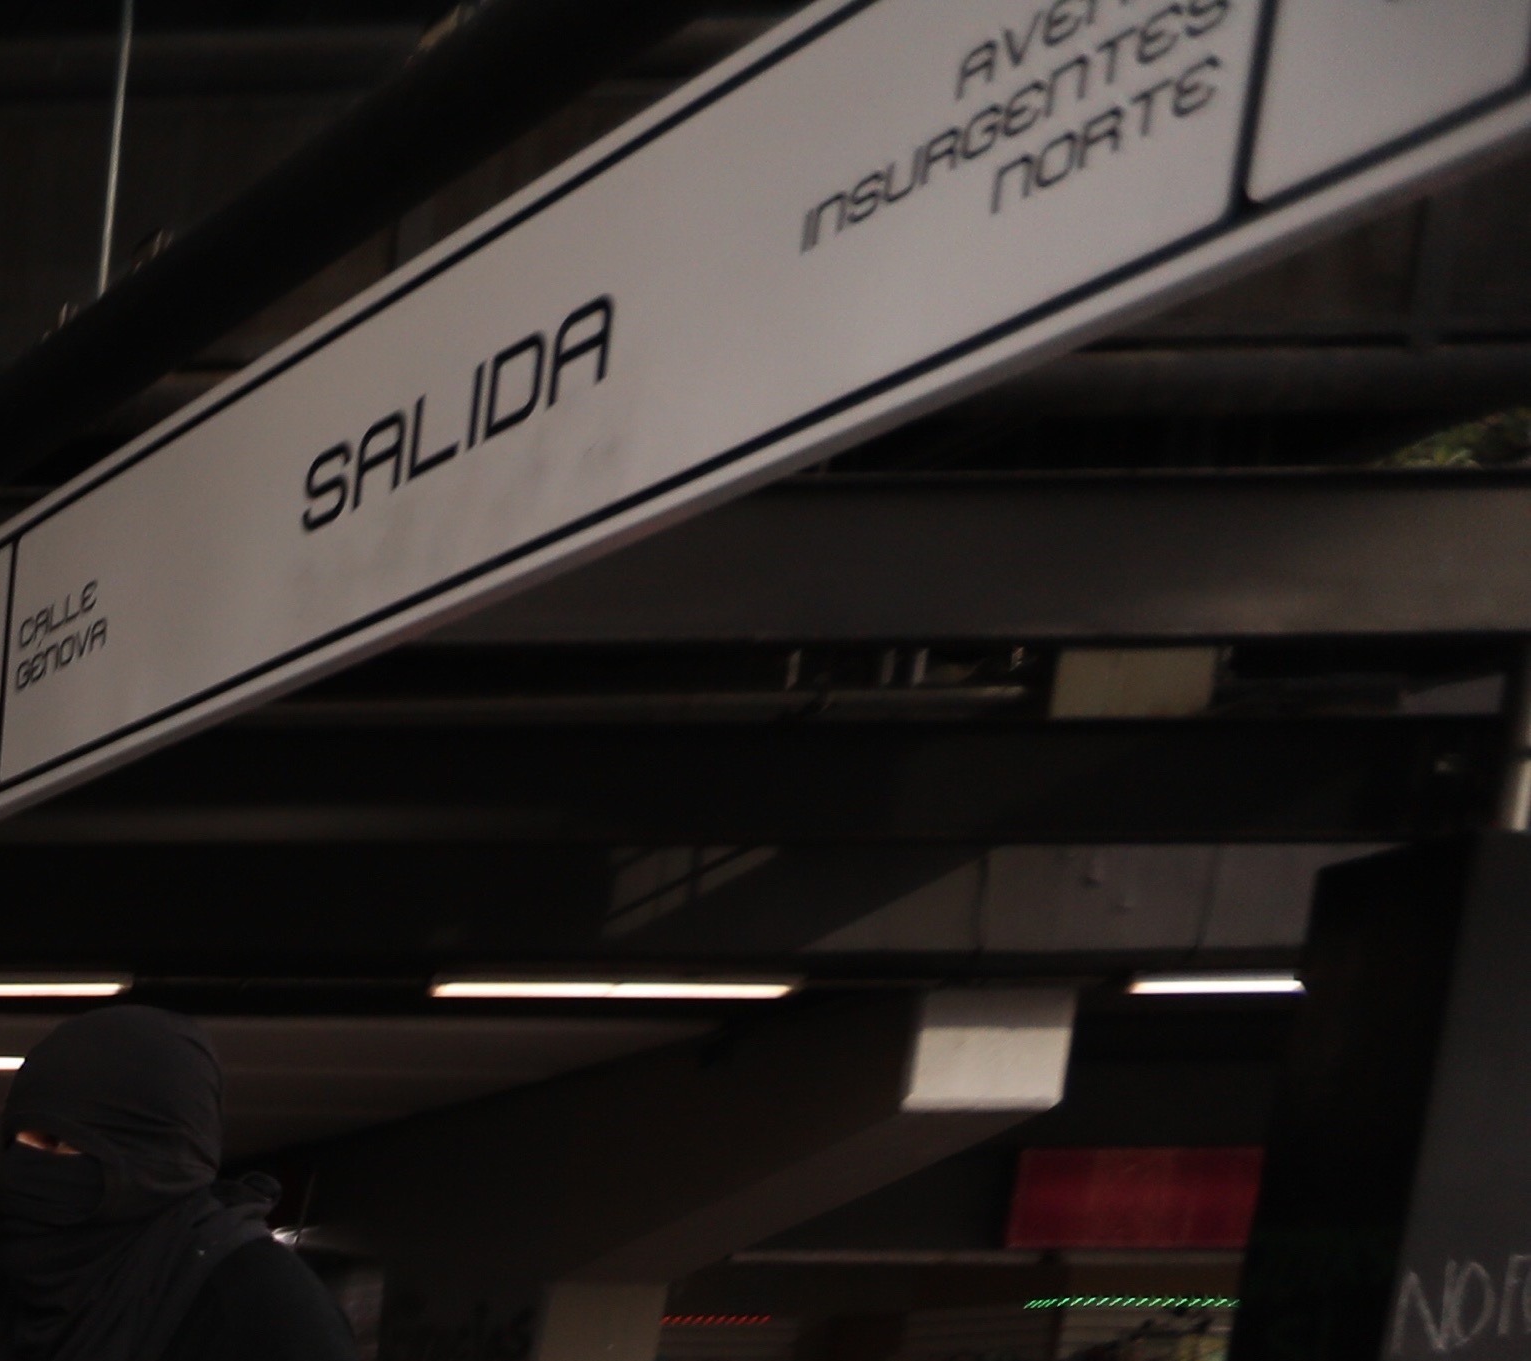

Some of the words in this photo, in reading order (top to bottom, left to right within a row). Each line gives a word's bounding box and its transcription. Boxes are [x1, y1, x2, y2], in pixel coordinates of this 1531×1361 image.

[800, 0, 1228, 254] INSURGENTES
[955, 0, 1109, 100] AVE
[989, 55, 1221, 214] NORTE
[301, 292, 615, 534] SALIDA
[17, 578, 99, 649] CALLE
